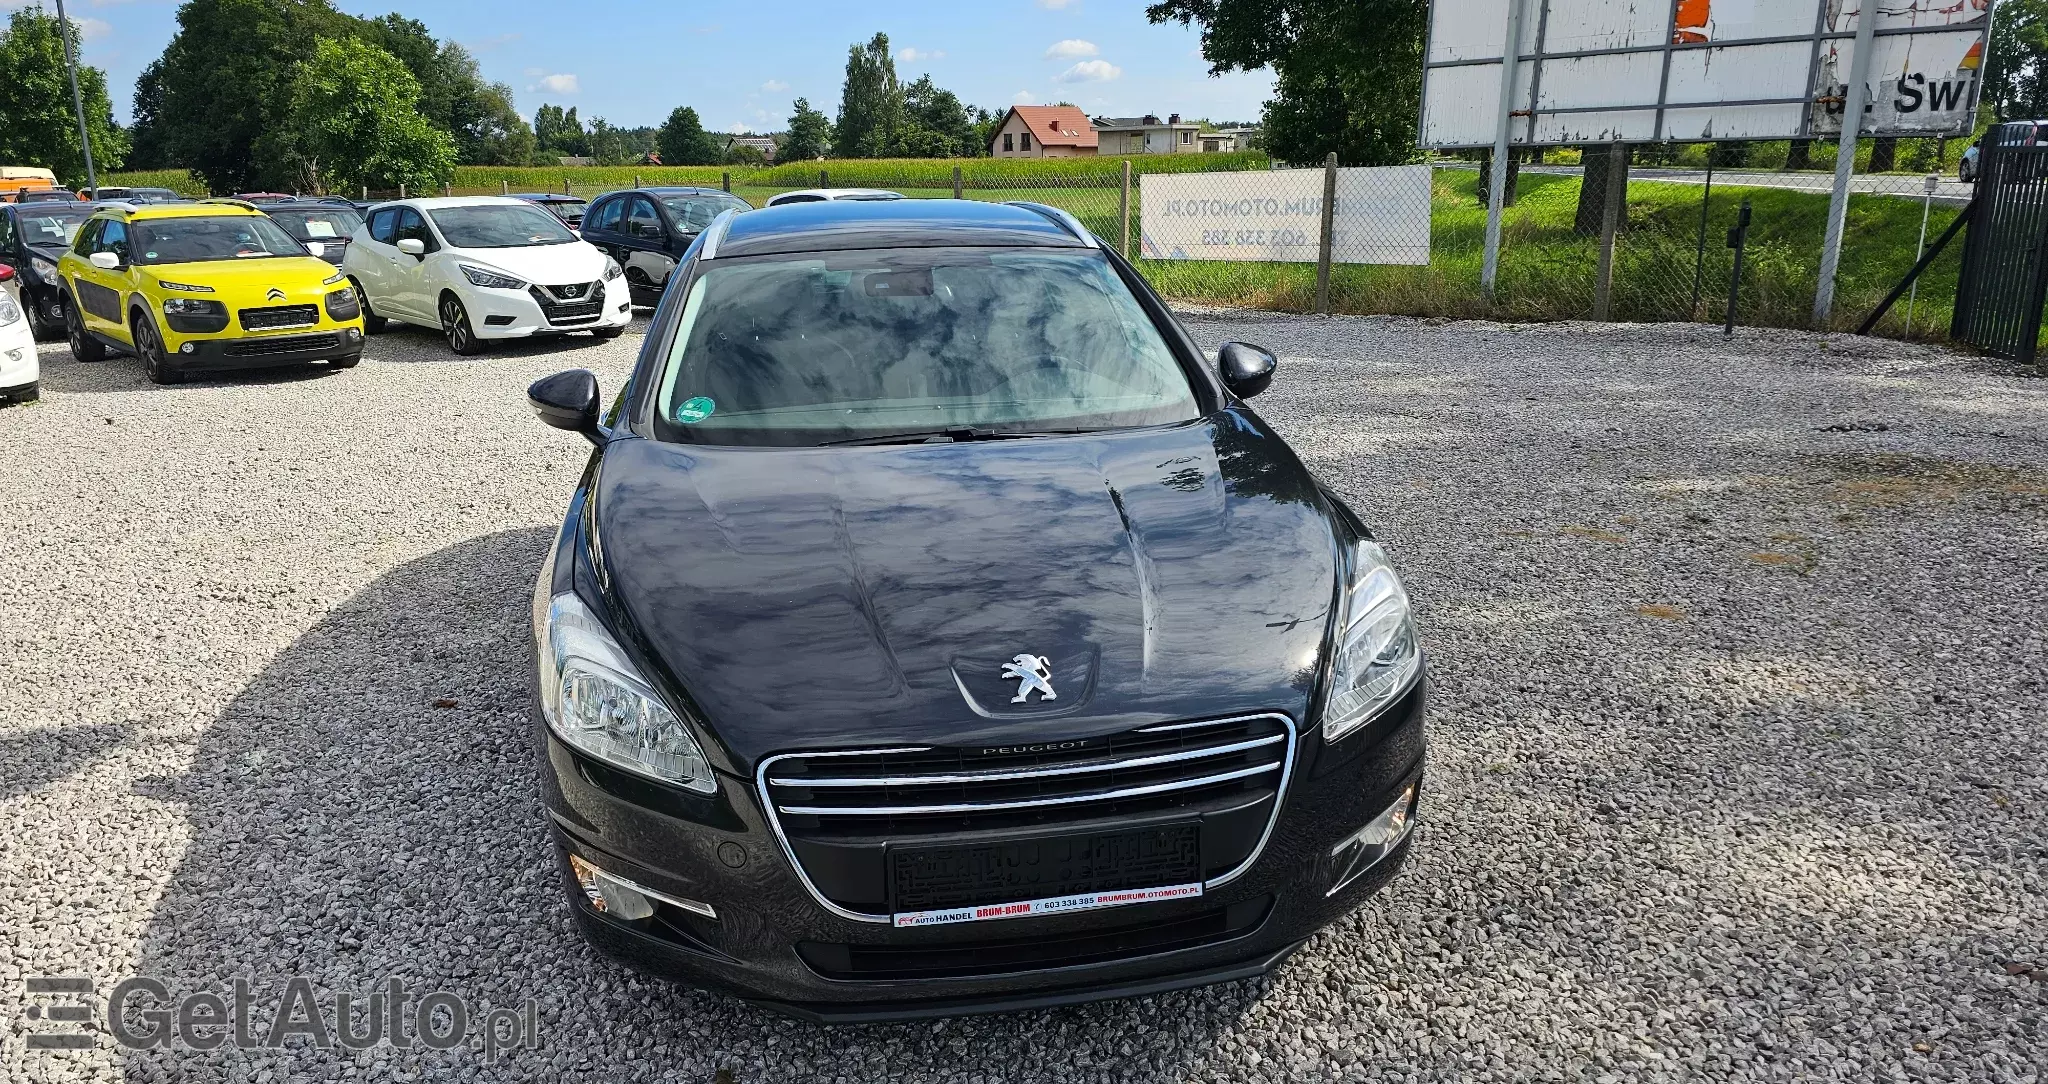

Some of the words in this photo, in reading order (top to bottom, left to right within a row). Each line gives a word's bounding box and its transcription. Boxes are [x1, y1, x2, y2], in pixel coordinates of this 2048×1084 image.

[983, 740, 1088, 755] PEUGEOT
[936, 911, 973, 923] HANDEL
[976, 903, 1031, 918] BRUM-BRUM
[1044, 901, 1060, 909] 603
[1061, 900, 1078, 908] 338
[1078, 897, 1095, 905] 385
[1097, 887, 1200, 903] BRUMBRUM.OTOMOTO.PL
